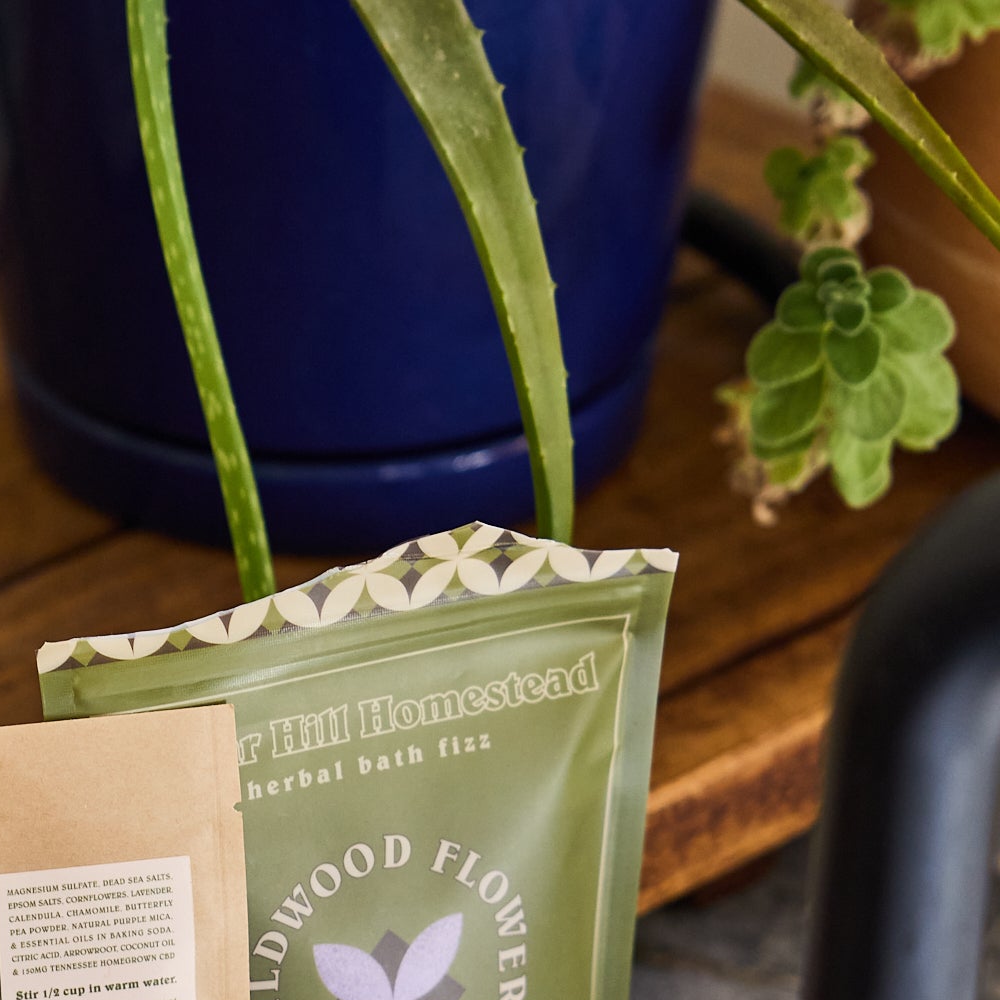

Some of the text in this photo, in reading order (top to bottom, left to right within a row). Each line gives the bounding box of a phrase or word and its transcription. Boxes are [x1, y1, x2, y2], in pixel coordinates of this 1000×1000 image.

[270, 704, 350, 758] Hill
[358, 652, 599, 738] Homestead
[248, 734, 491, 801] herbal bath fizz
[7, 885, 59, 896] MAGNESIUM
[103, 878, 125, 887] DEAD
[128, 876, 143, 884] SEA
[146, 873, 173, 882] SALTS,
[8, 901, 36, 910] EPSOM
[38, 898, 64, 906] SALTS,
[66, 891, 128, 904] CORNFLOWERS,
[9, 900, 173, 923] CALENDULA, CHAMOMILE, BUTTERFLY
[30, 924, 69, 934] POWDER,
[72, 919, 111, 929] NATURAL
[114, 915, 147, 925] PURPLE
[20, 937, 69, 948] ESSENTIAL
[73, 935, 94, 943] OILS
[110, 929, 144, 939] BAKING
[12, 953, 38, 962] CITRIC
[41, 951, 61, 960] ACID,
[121, 941, 159, 951] COCONUT
[22, 965, 47, 975] 150MG
[50, 961, 98, 972] TENNESSEE
[100, 955, 157, 966] HOMEGROWN
[16, 976, 177, 1000] Stir 1/2 cup in warm water.
